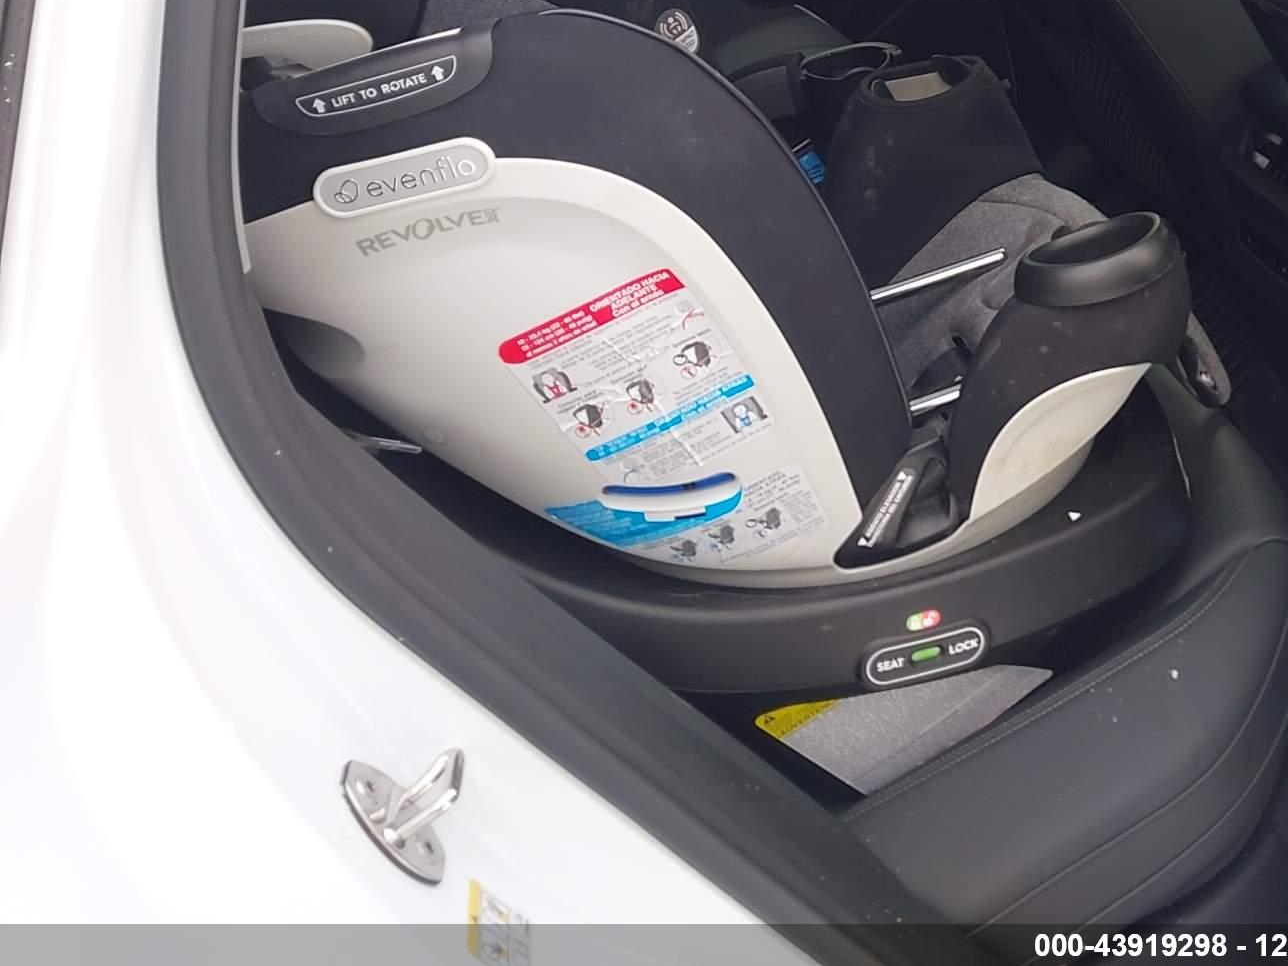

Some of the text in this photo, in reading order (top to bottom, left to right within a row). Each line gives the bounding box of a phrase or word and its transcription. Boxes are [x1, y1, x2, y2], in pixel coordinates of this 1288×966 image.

[331, 72, 428, 108] LIFT TO ROTATE
[366, 155, 476, 197] evenflo
[876, 637, 979, 673] SEAT LOCK
